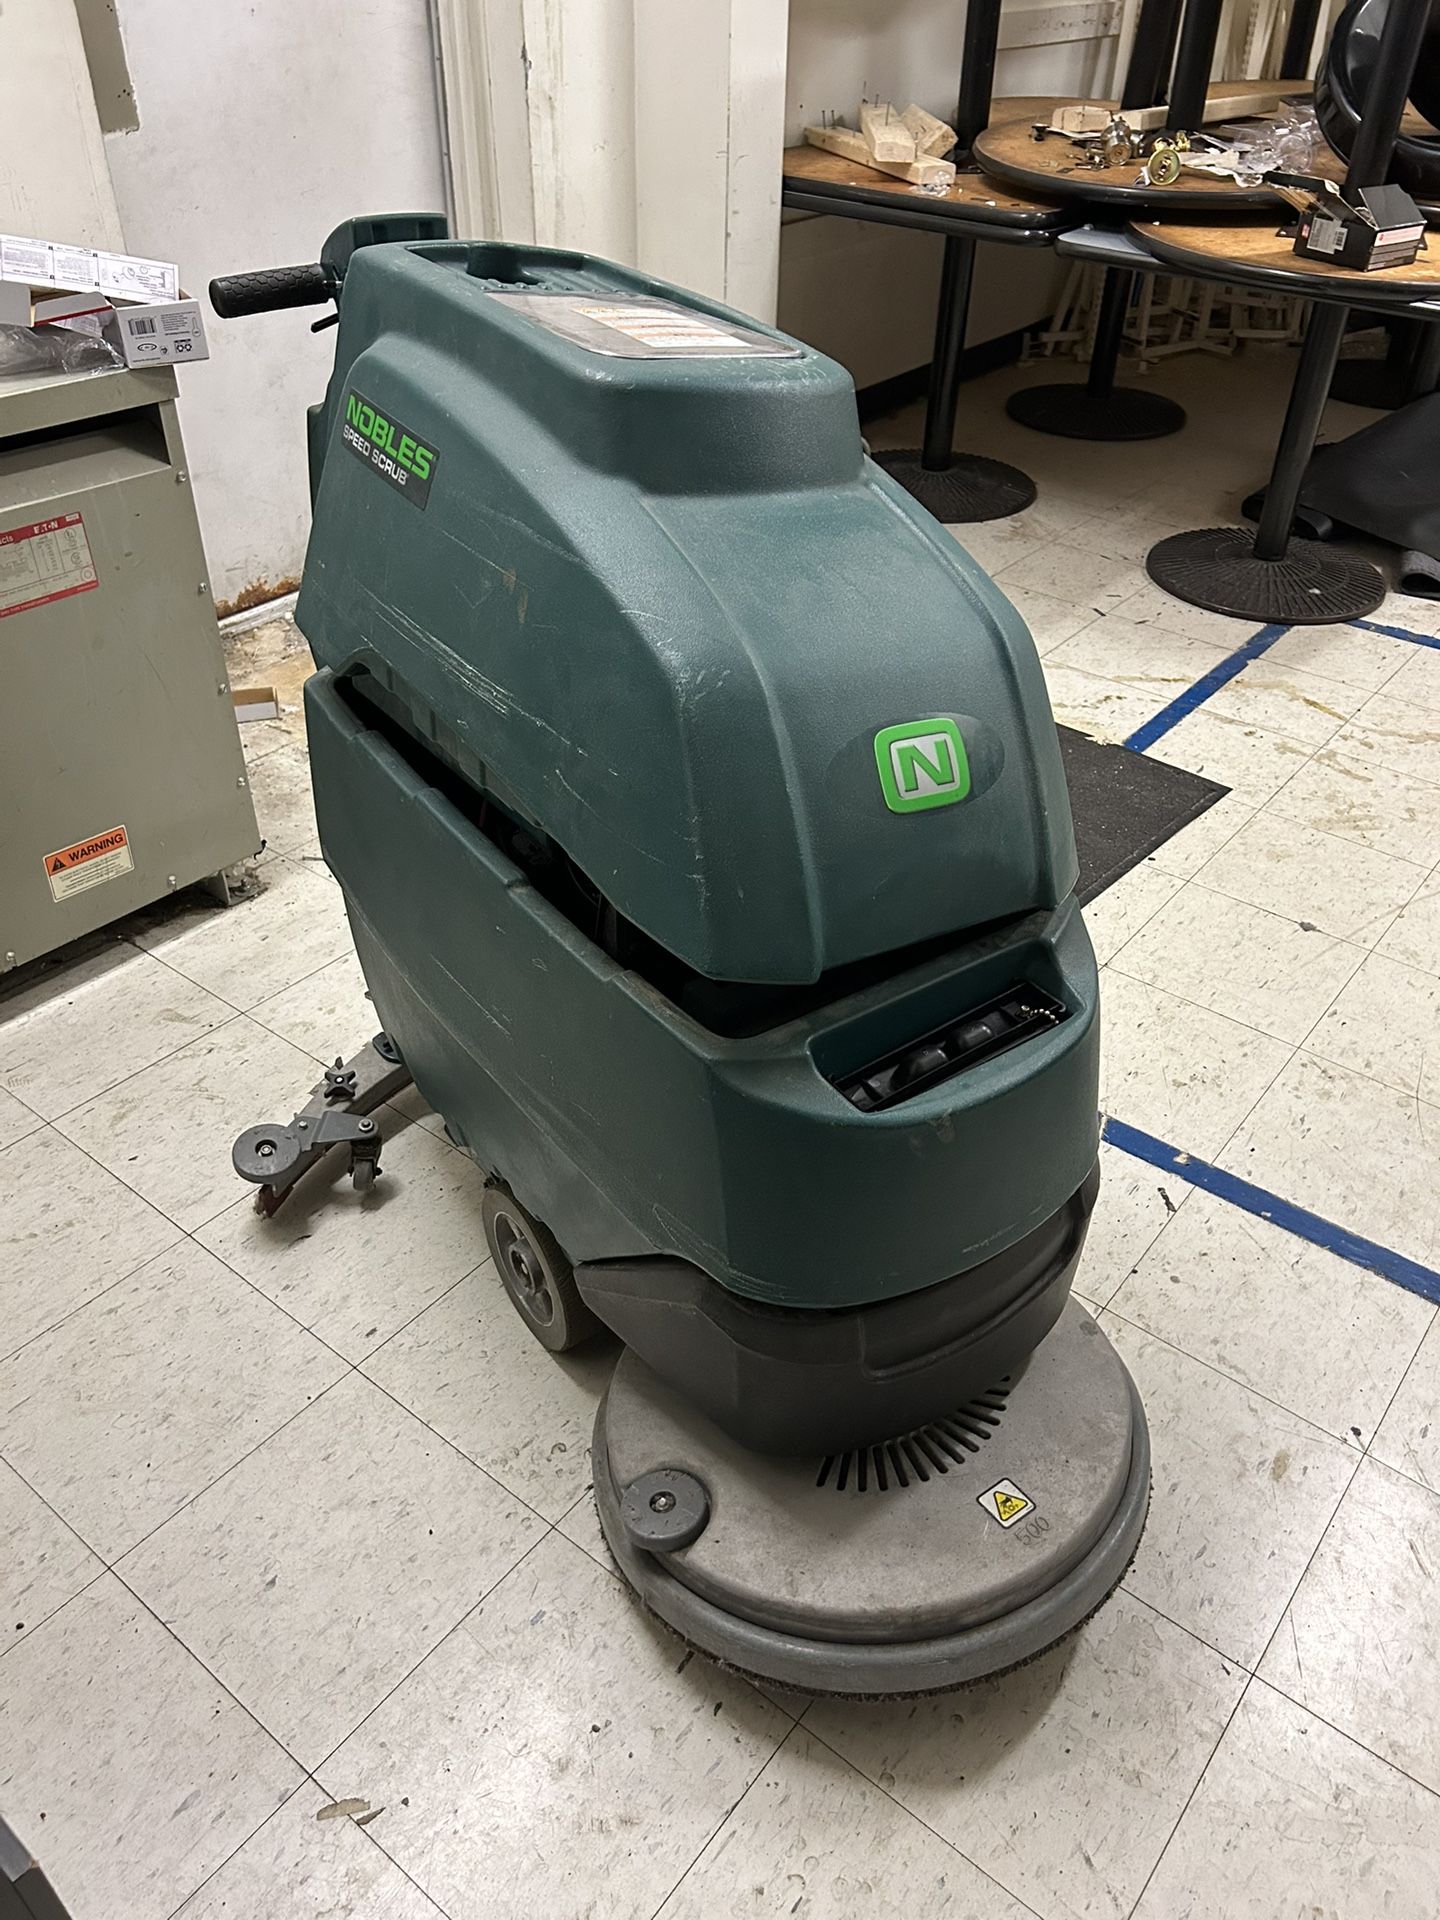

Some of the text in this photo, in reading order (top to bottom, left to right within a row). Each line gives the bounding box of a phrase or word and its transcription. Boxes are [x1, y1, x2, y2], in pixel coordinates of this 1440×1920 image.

[343, 424, 408, 485] SPEED SCRUB
[346, 394, 434, 480] NOBLES
[896, 739, 955, 792] N
[68, 833, 123, 862] WARNING
[1014, 1516, 1051, 1546] 500
